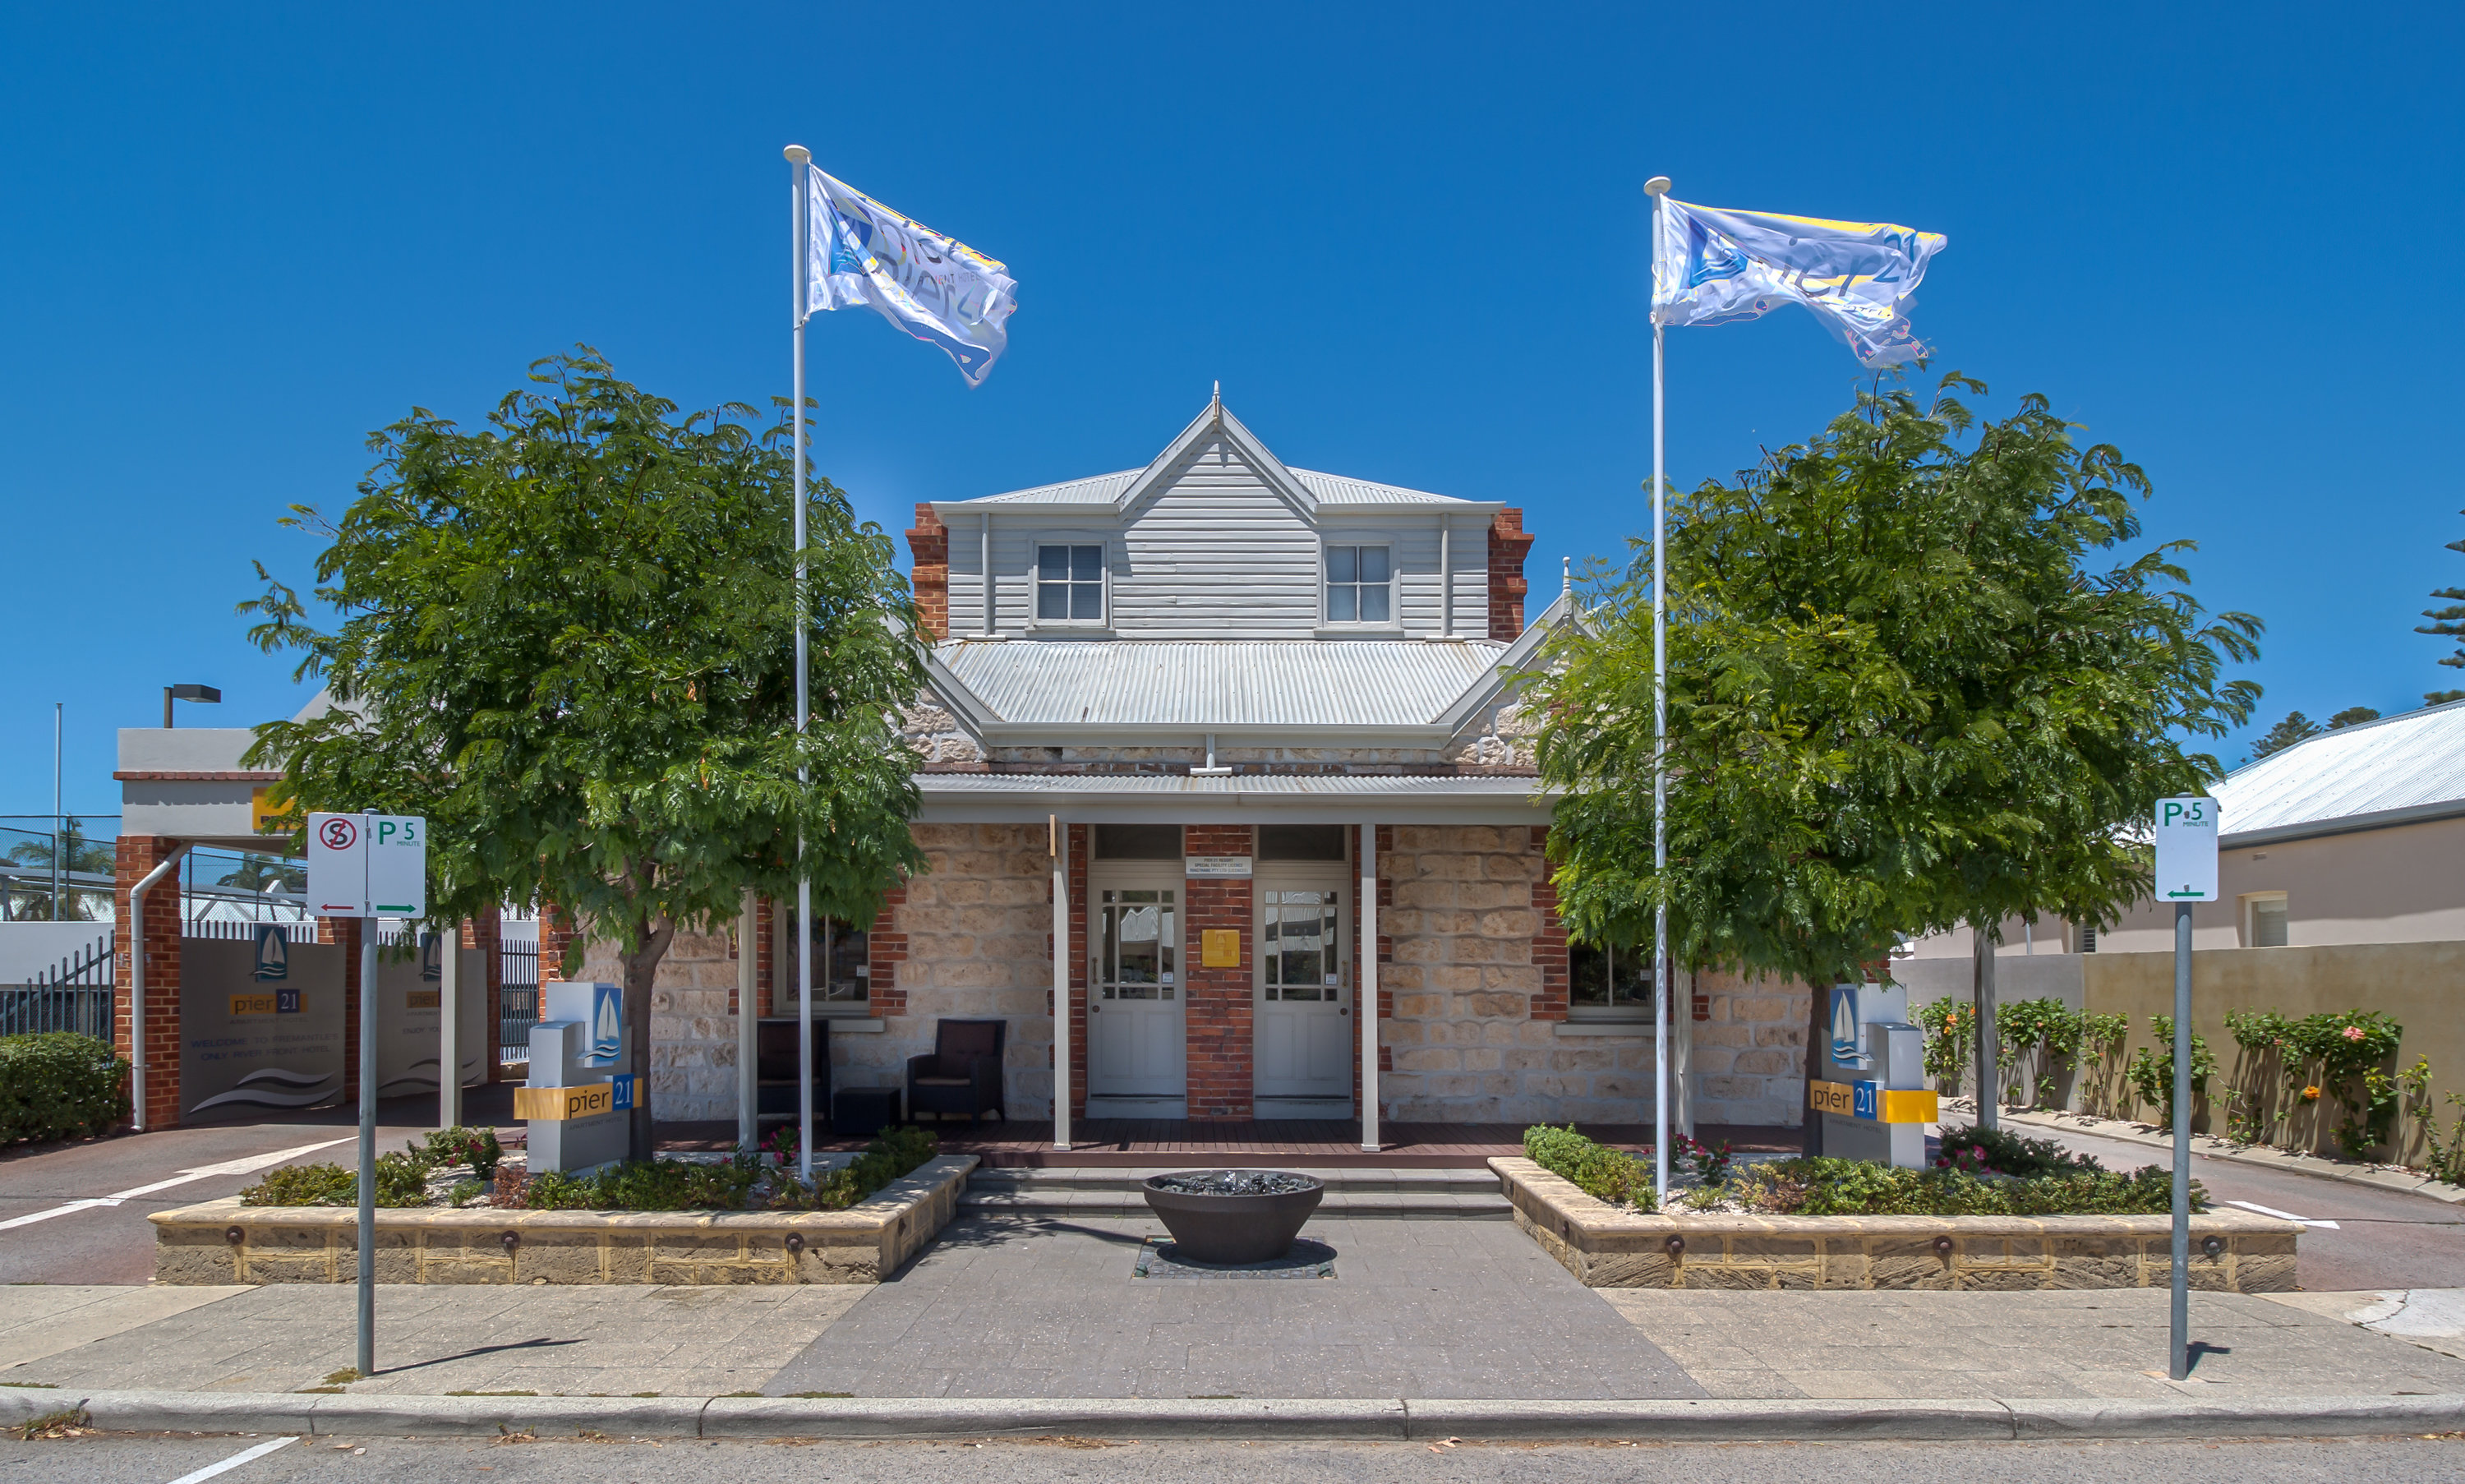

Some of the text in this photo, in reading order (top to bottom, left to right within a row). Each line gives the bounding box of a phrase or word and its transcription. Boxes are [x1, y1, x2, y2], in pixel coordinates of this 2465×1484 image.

[2164, 802, 2202, 827] P 5
[379, 821, 414, 845] P 5
[234, 993, 297, 1015] pier 21
[409, 993, 435, 1008] pier
[403, 1026, 425, 1035] ENJOY
[191, 1037, 247, 1048] WELCOME
[200, 1045, 330, 1062] ONLY RIVER FRONT HOTEL
[569, 1080, 632, 1118] pier 21
[1813, 1086, 1874, 1114] pier 21
[1829, 1118, 1883, 1134] APARTMENT HOTEL
